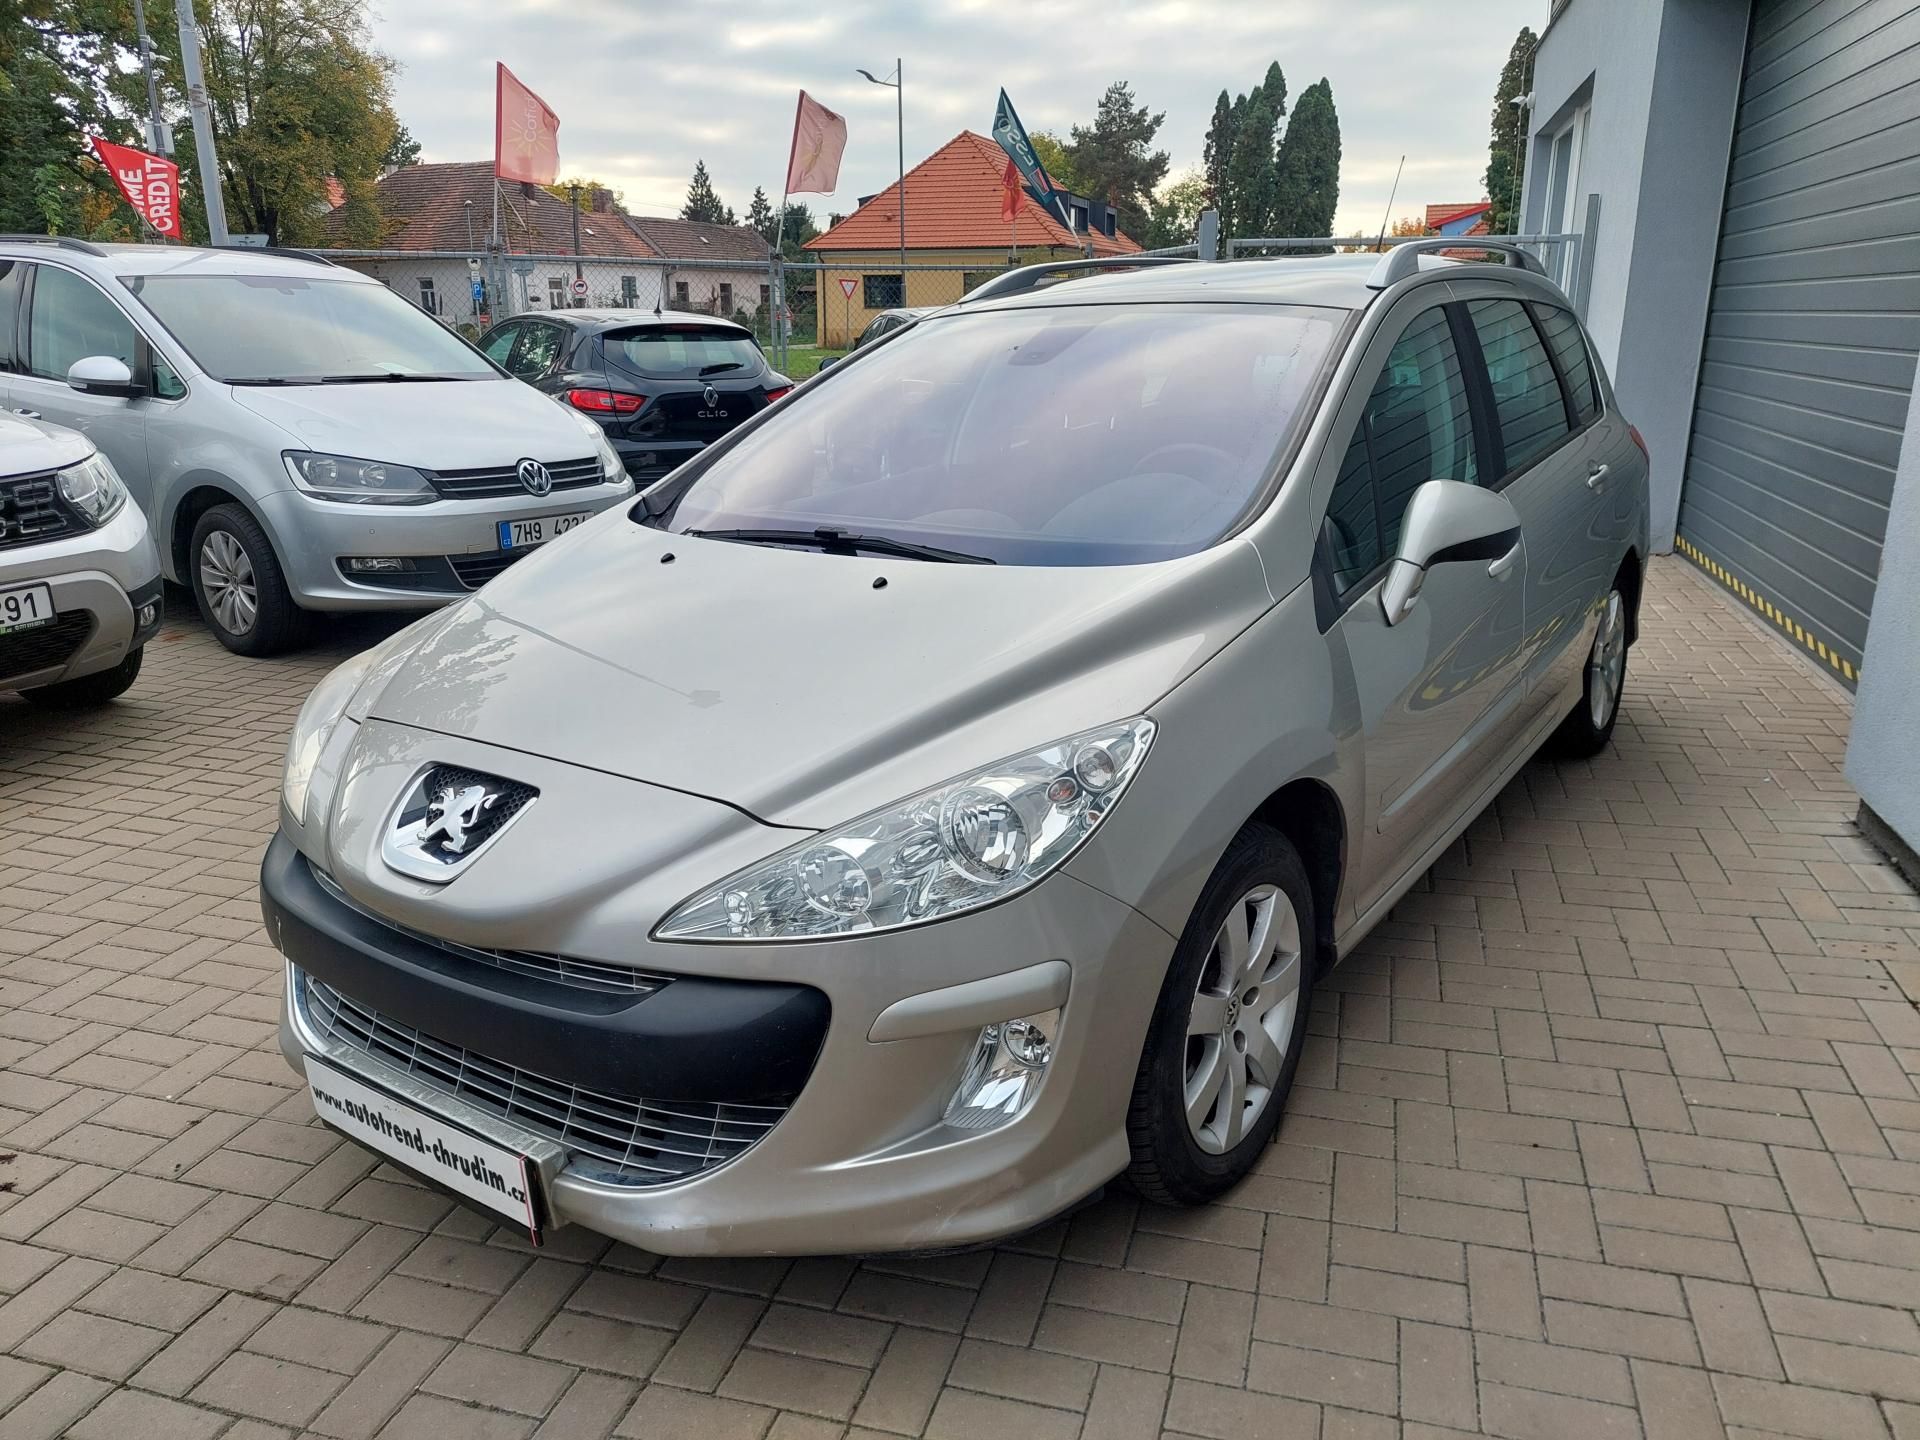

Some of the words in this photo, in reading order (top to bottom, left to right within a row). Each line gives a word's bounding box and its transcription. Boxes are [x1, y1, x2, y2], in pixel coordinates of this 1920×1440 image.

[145, 158, 173, 232] CREDIT
[697, 410, 728, 418] CLIO
[514, 522, 543, 544] 7H9
[312, 1085, 528, 1205] www.autotrend-chrudim.cz
